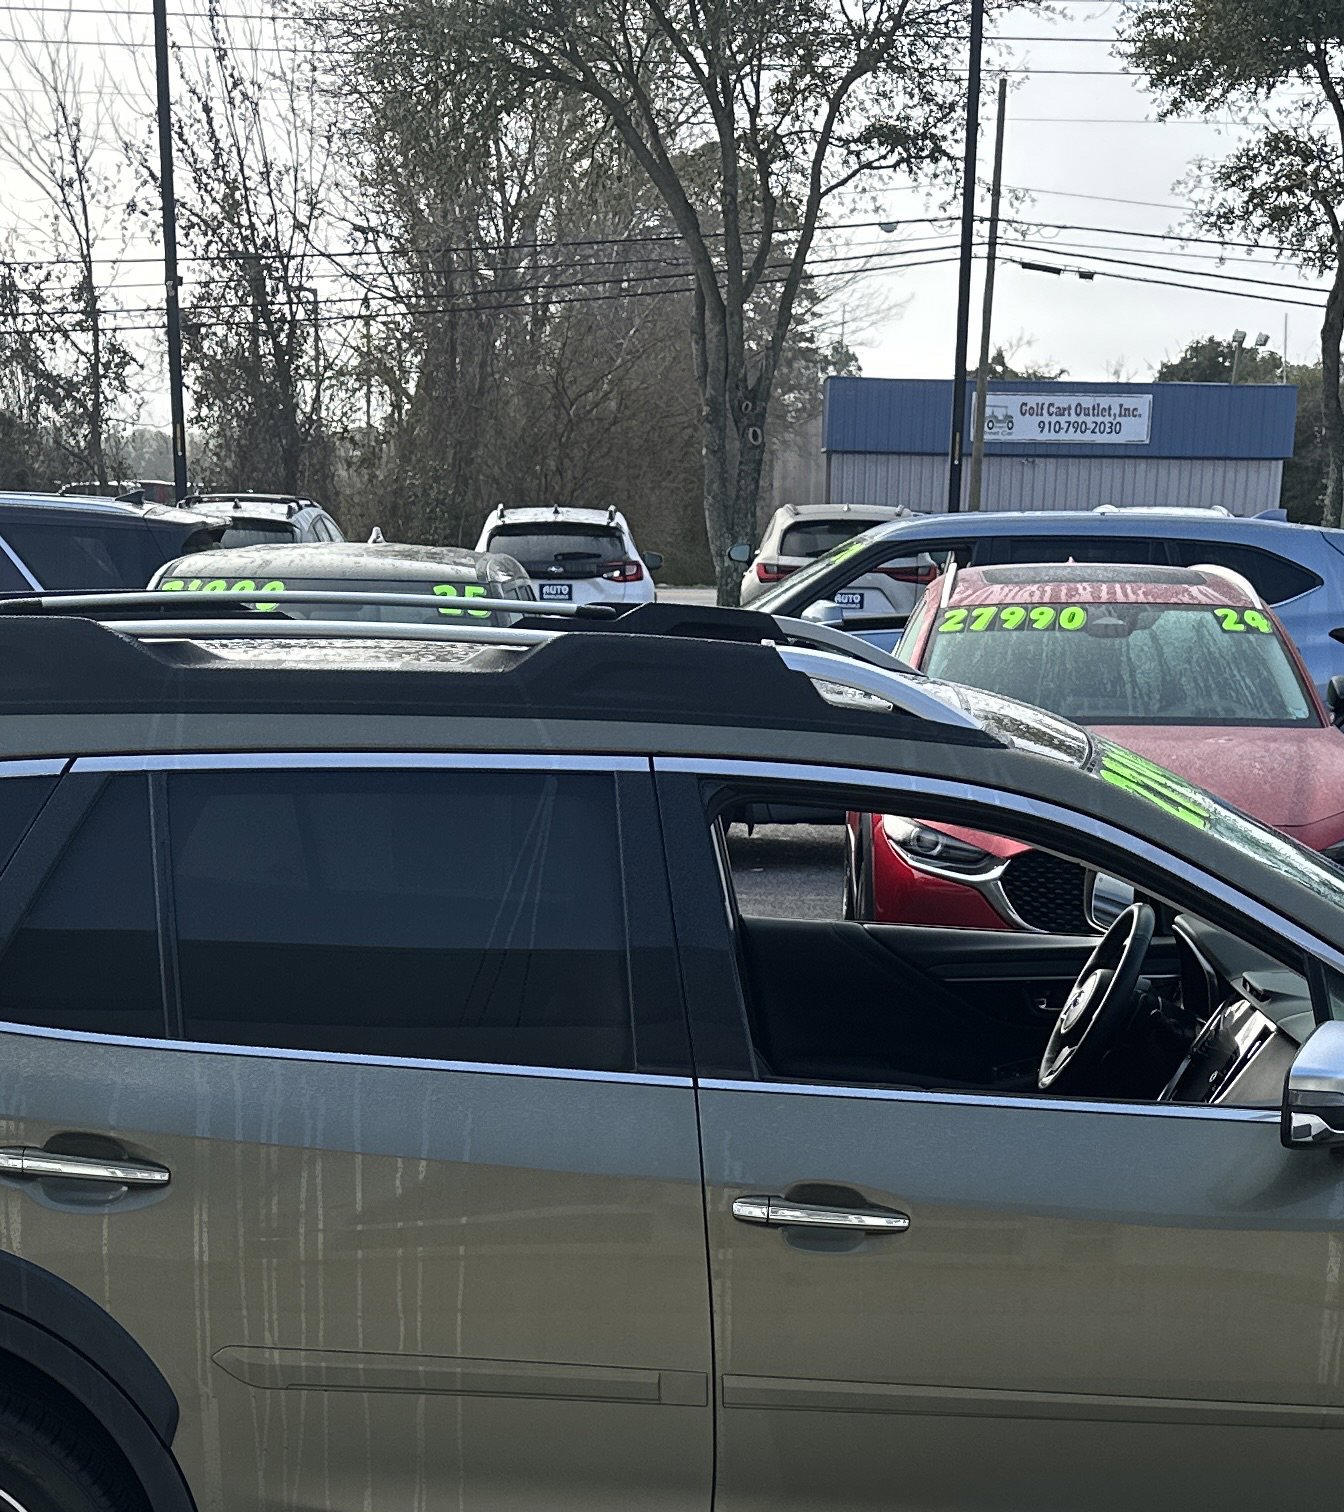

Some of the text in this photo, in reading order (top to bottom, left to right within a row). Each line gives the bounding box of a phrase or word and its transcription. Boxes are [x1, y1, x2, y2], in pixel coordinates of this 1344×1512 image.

[1019, 402, 1045, 417] Golf
[1047, 403, 1071, 418] Cart
[1118, 403, 1142, 418] Inc.
[1038, 421, 1122, 434] 910-790-2030
[542, 585, 569, 595] AUTO
[835, 593, 861, 603] AUTO
[938, 606, 1088, 633] 27990
